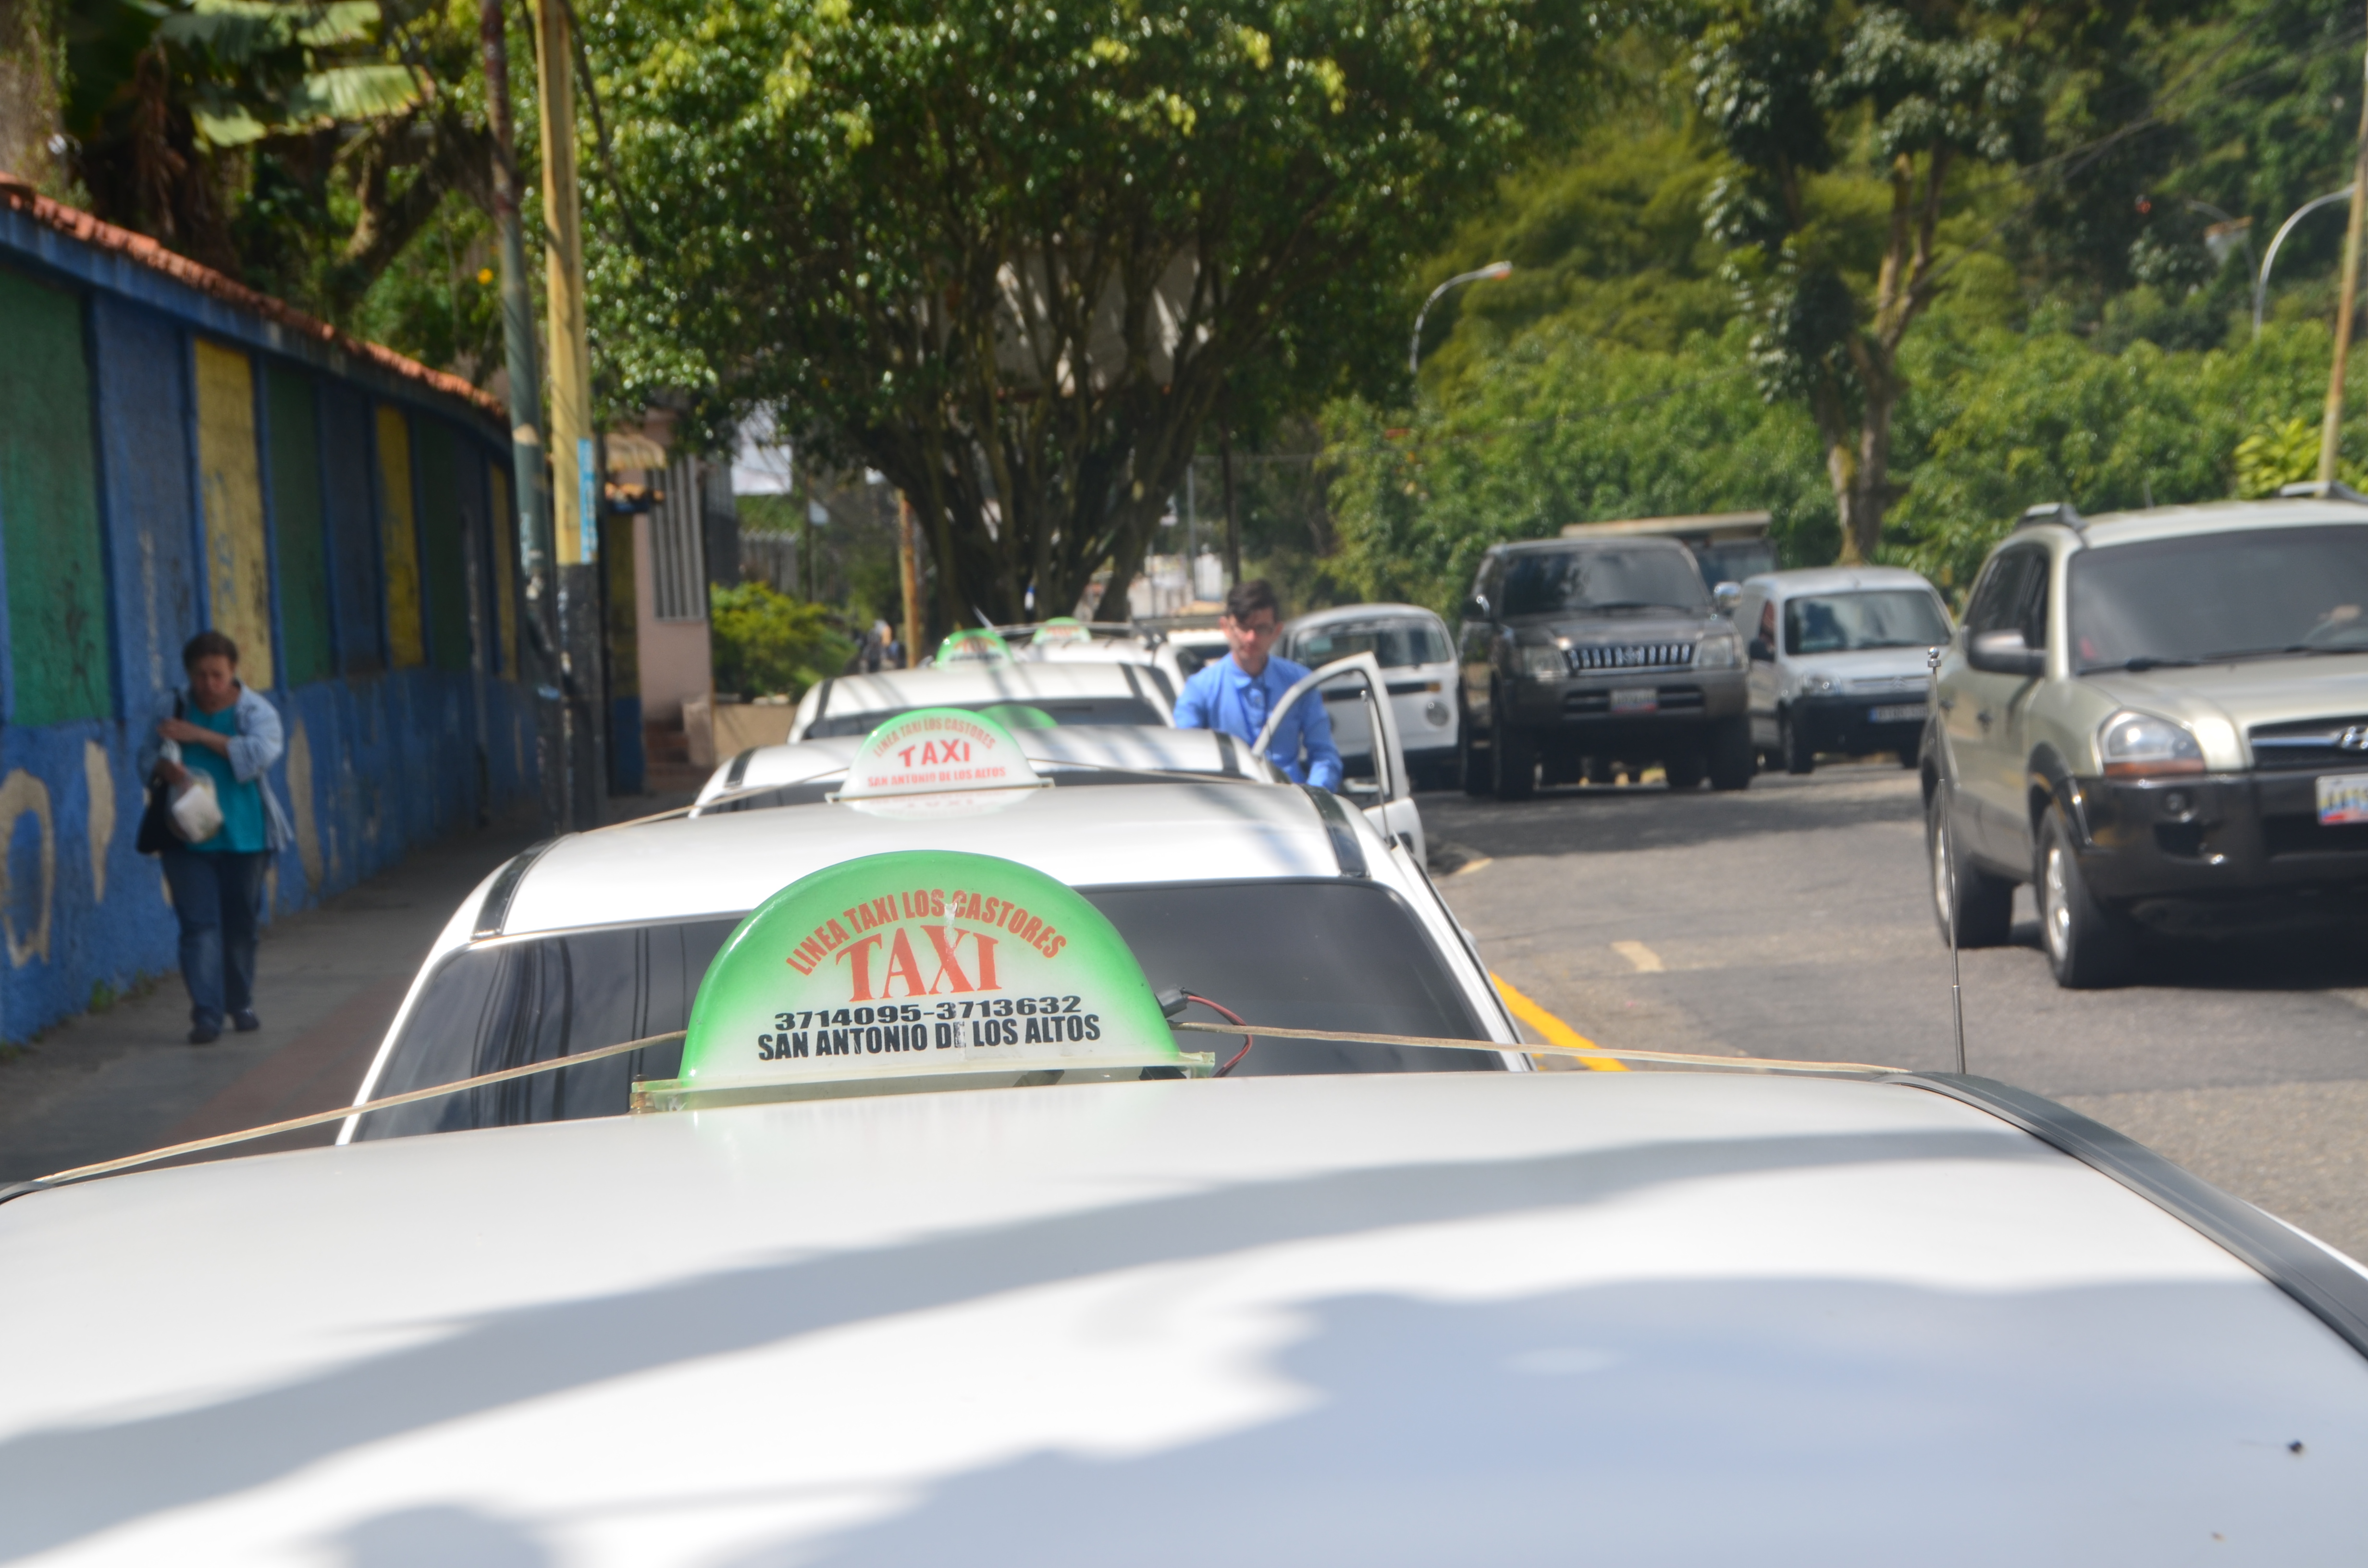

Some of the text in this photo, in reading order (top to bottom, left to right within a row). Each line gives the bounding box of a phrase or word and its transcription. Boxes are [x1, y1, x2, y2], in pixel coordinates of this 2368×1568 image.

[873, 718, 996, 758] LINEA TAXI LOS CASTORES
[898, 739, 970, 767] TAXI
[868, 766, 1006, 787] SAN ANTONIO DE LOS ALTOS
[786, 889, 1067, 976] LINEA TAXI LOS CASTORES
[836, 925, 1002, 1002] TAXI
[775, 995, 1082, 1030] 3714095-3713632
[758, 1014, 1100, 1061] SAN ANTONIO DE LOS ALTOS
